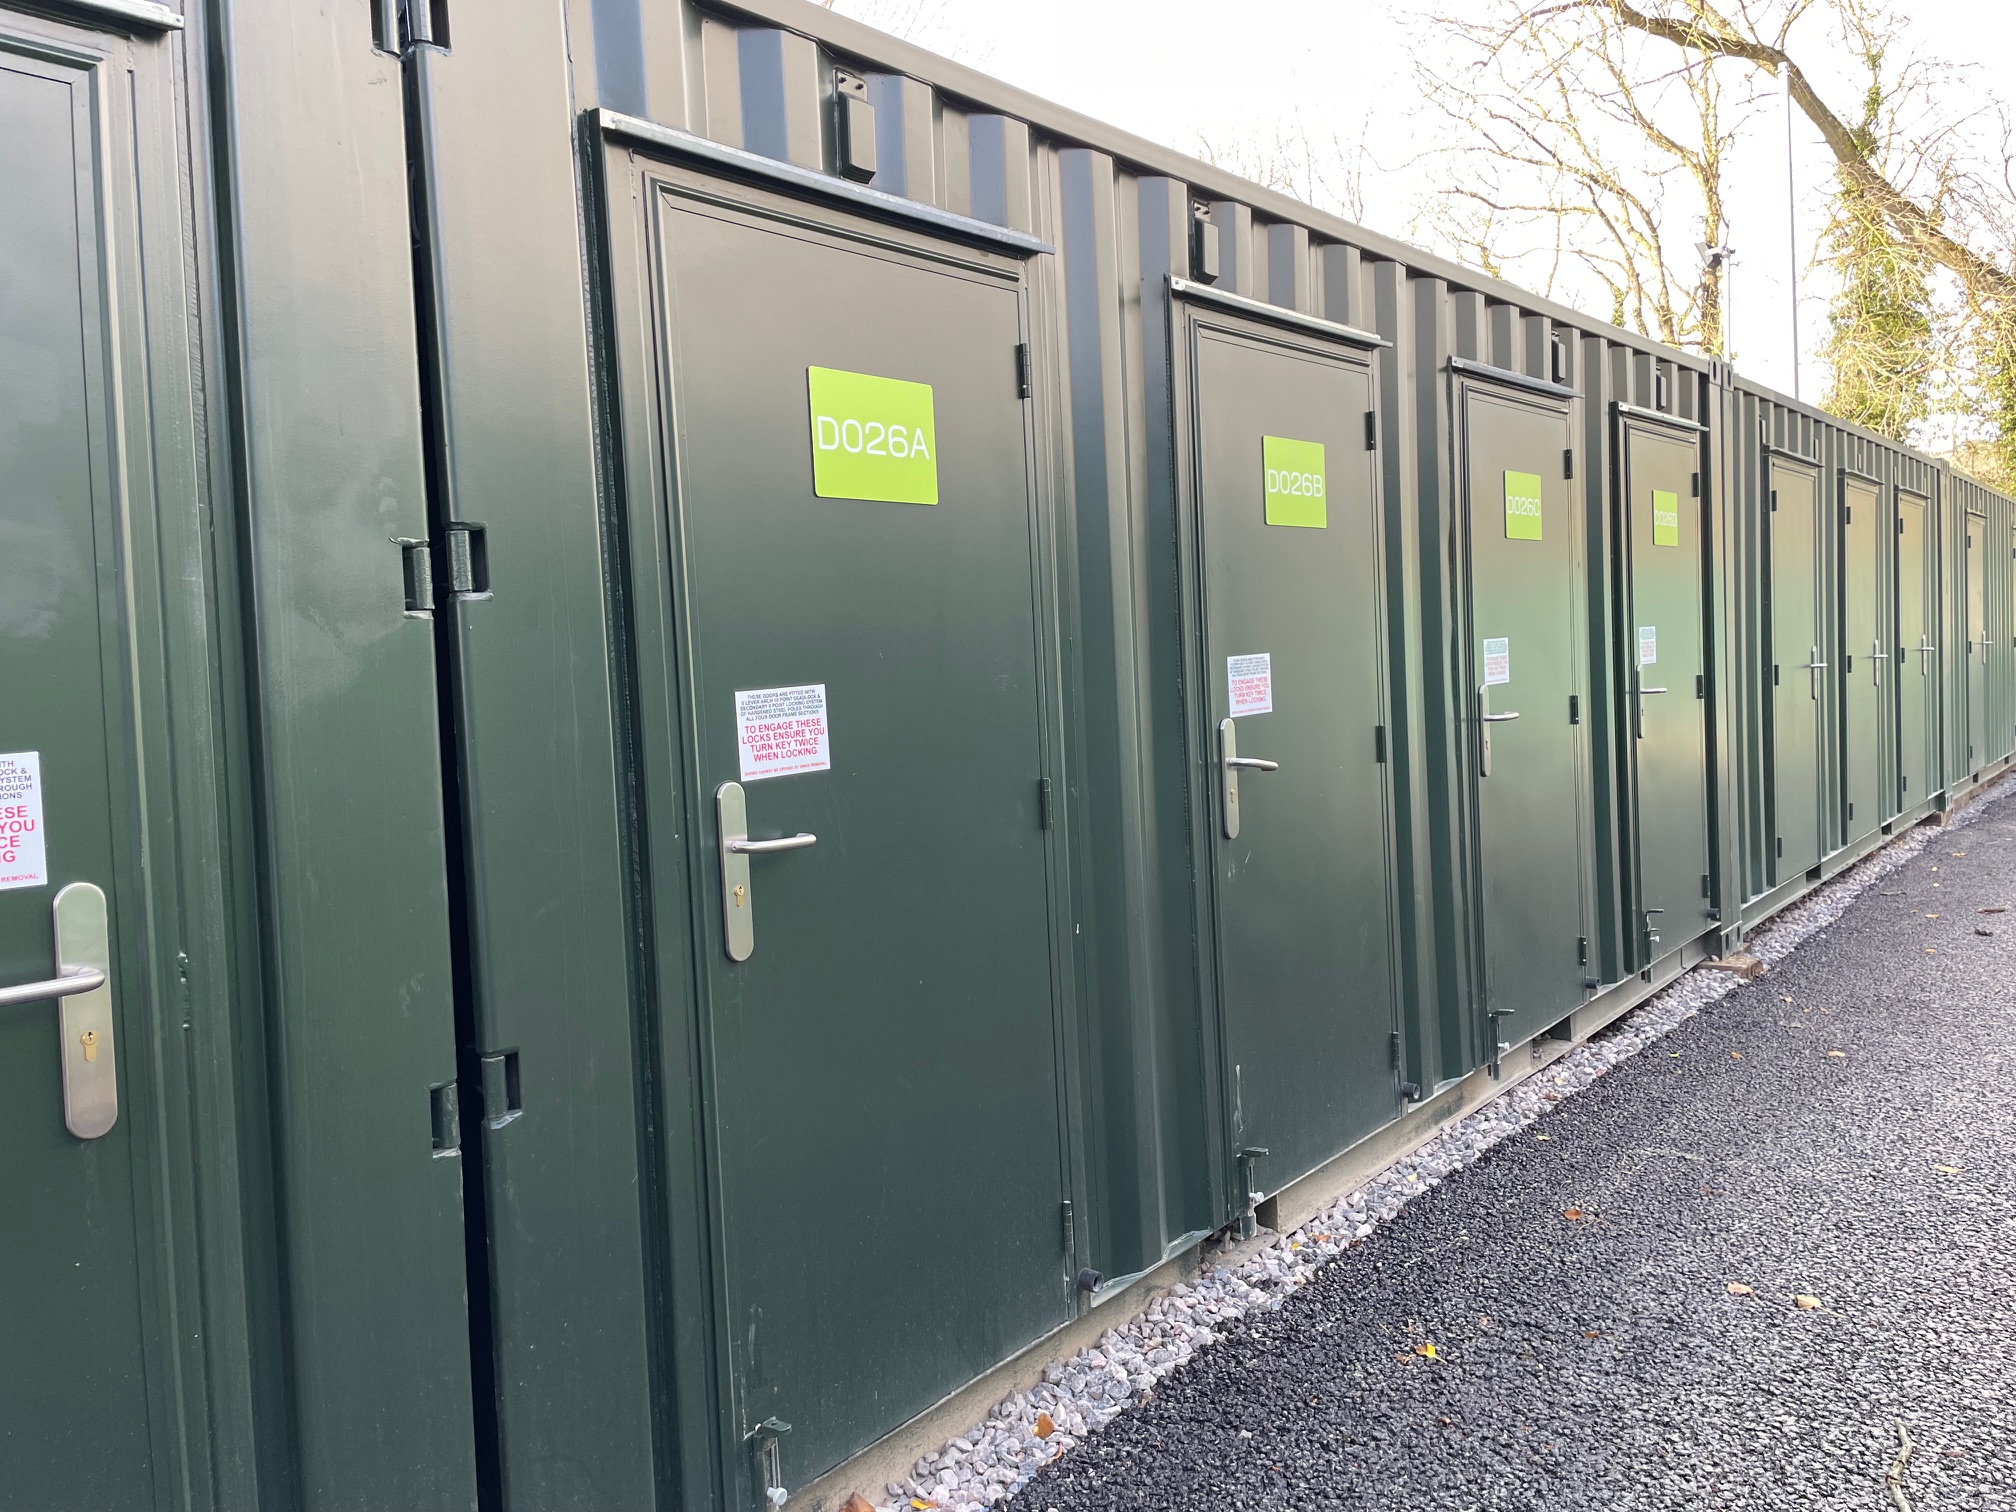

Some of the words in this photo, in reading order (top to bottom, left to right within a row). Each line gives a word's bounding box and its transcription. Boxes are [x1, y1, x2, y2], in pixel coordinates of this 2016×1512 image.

[817, 415, 930, 460] D026A
[1268, 469, 1323, 497] D026B
[1508, 496, 1540, 516] D026C
[745, 726, 756, 734] TO
[758, 721, 793, 733] ENGAGE
[795, 718, 821, 728] THESE
[742, 733, 771, 744] LOCKS
[773, 729, 806, 740] ENSURE
[808, 727, 824, 735] YOU
[750, 743, 773, 753] TURN
[776, 740, 791, 749] KEY
[794, 737, 819, 747] TWICE
[754, 751, 778, 762] WHEN
[781, 747, 817, 758] LOCKING
[0, 760, 14, 768] ITH
[0, 775, 32, 784] YSTEM
[0, 783, 33, 792] ROUGH
[0, 791, 23, 800] IONS
[0, 805, 28, 820] ESE
[0, 819, 35, 835] YOU
[1, 873, 39, 882] REMOVAL
